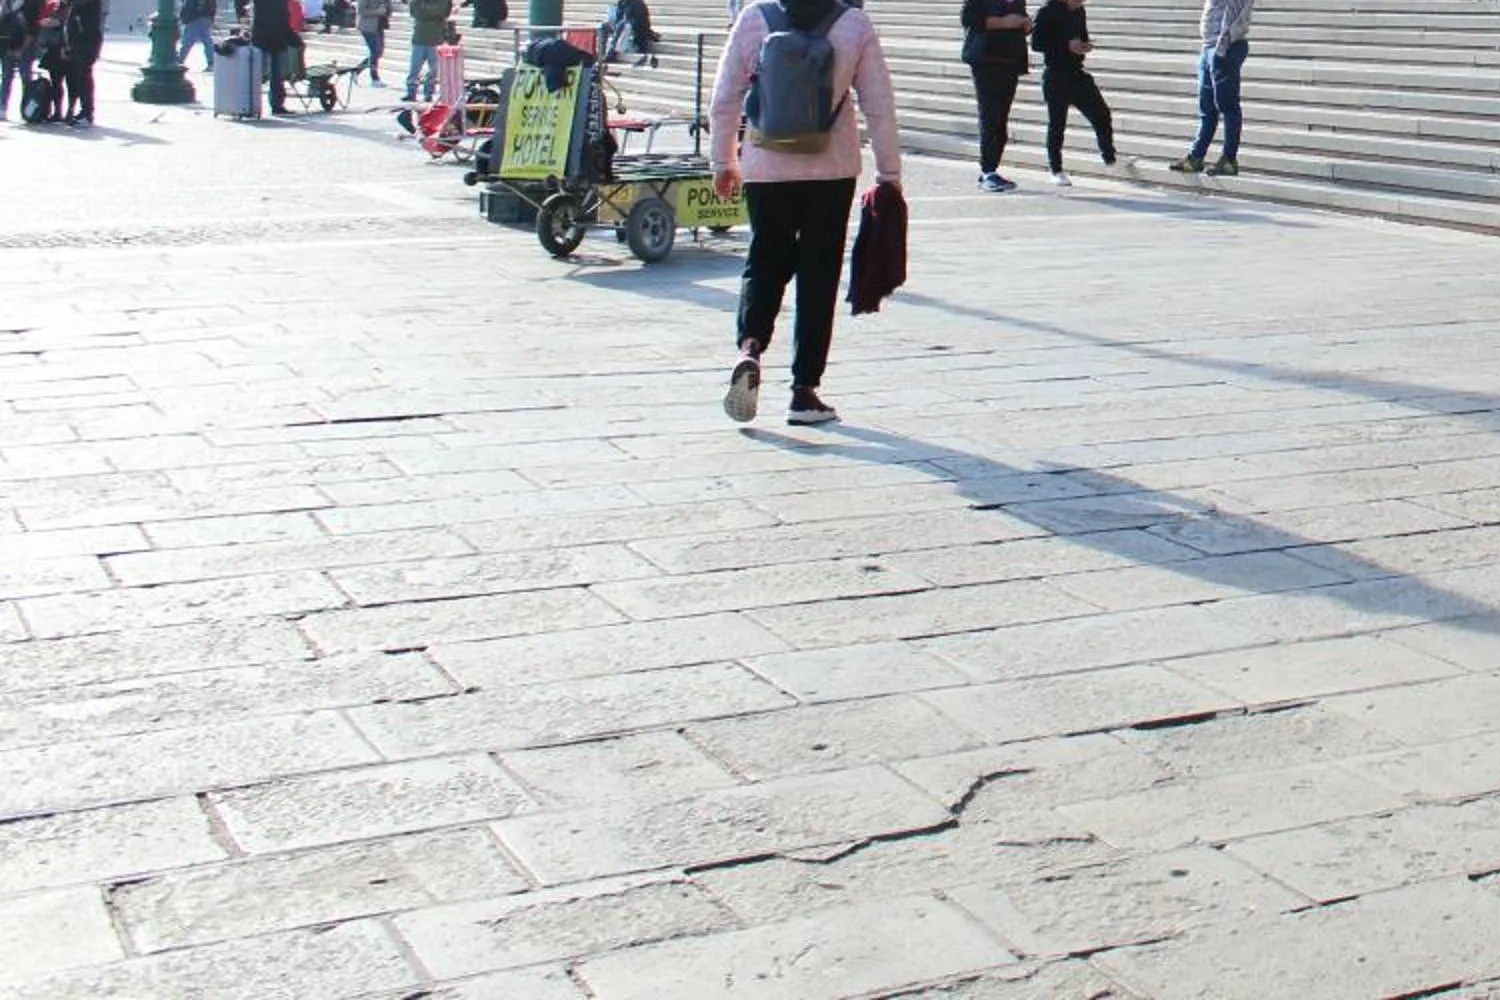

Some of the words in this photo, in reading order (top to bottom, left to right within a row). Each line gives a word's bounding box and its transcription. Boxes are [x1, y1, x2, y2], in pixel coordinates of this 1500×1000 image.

[520, 105, 558, 128] SERVICE
[511, 134, 557, 165] HOTEL
[697, 207, 739, 218] SERVICE
